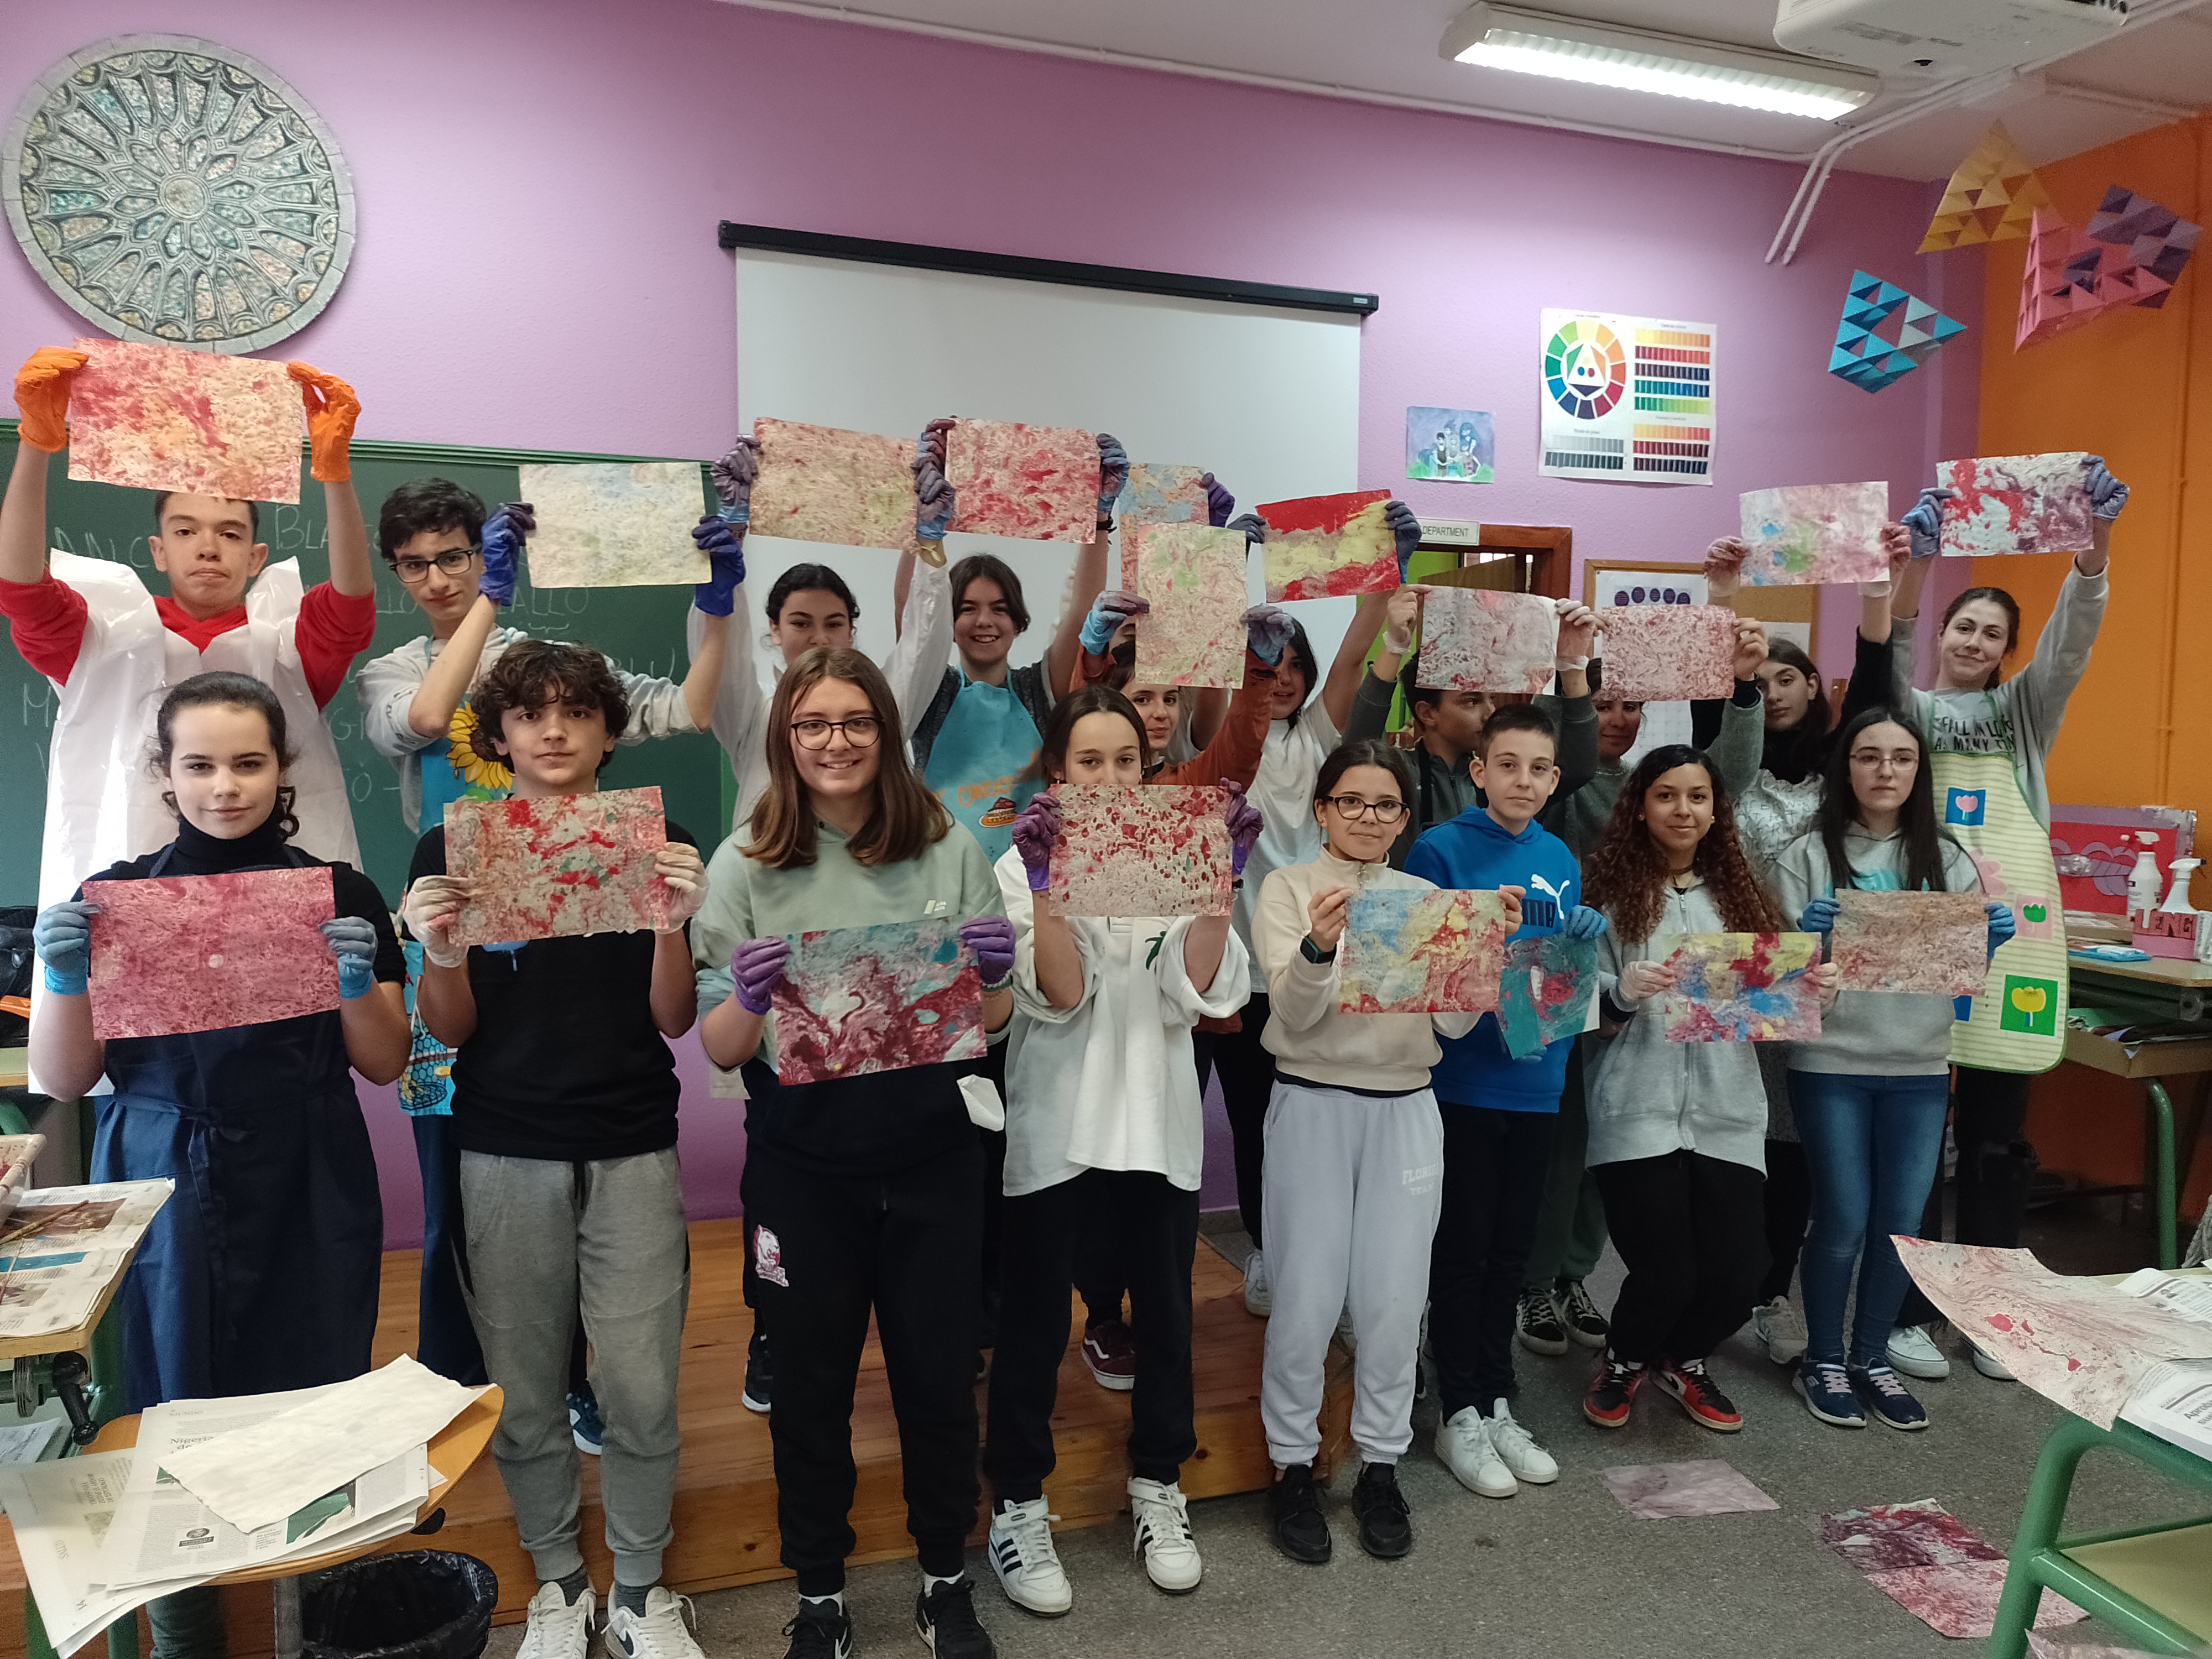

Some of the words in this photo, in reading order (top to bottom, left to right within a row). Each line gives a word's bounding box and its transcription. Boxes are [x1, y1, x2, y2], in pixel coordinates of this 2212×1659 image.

[1422, 526, 1469, 537] DEPARTMENT
[1953, 735, 1989, 752] MANY
[1522, 898, 1556, 928] MA
